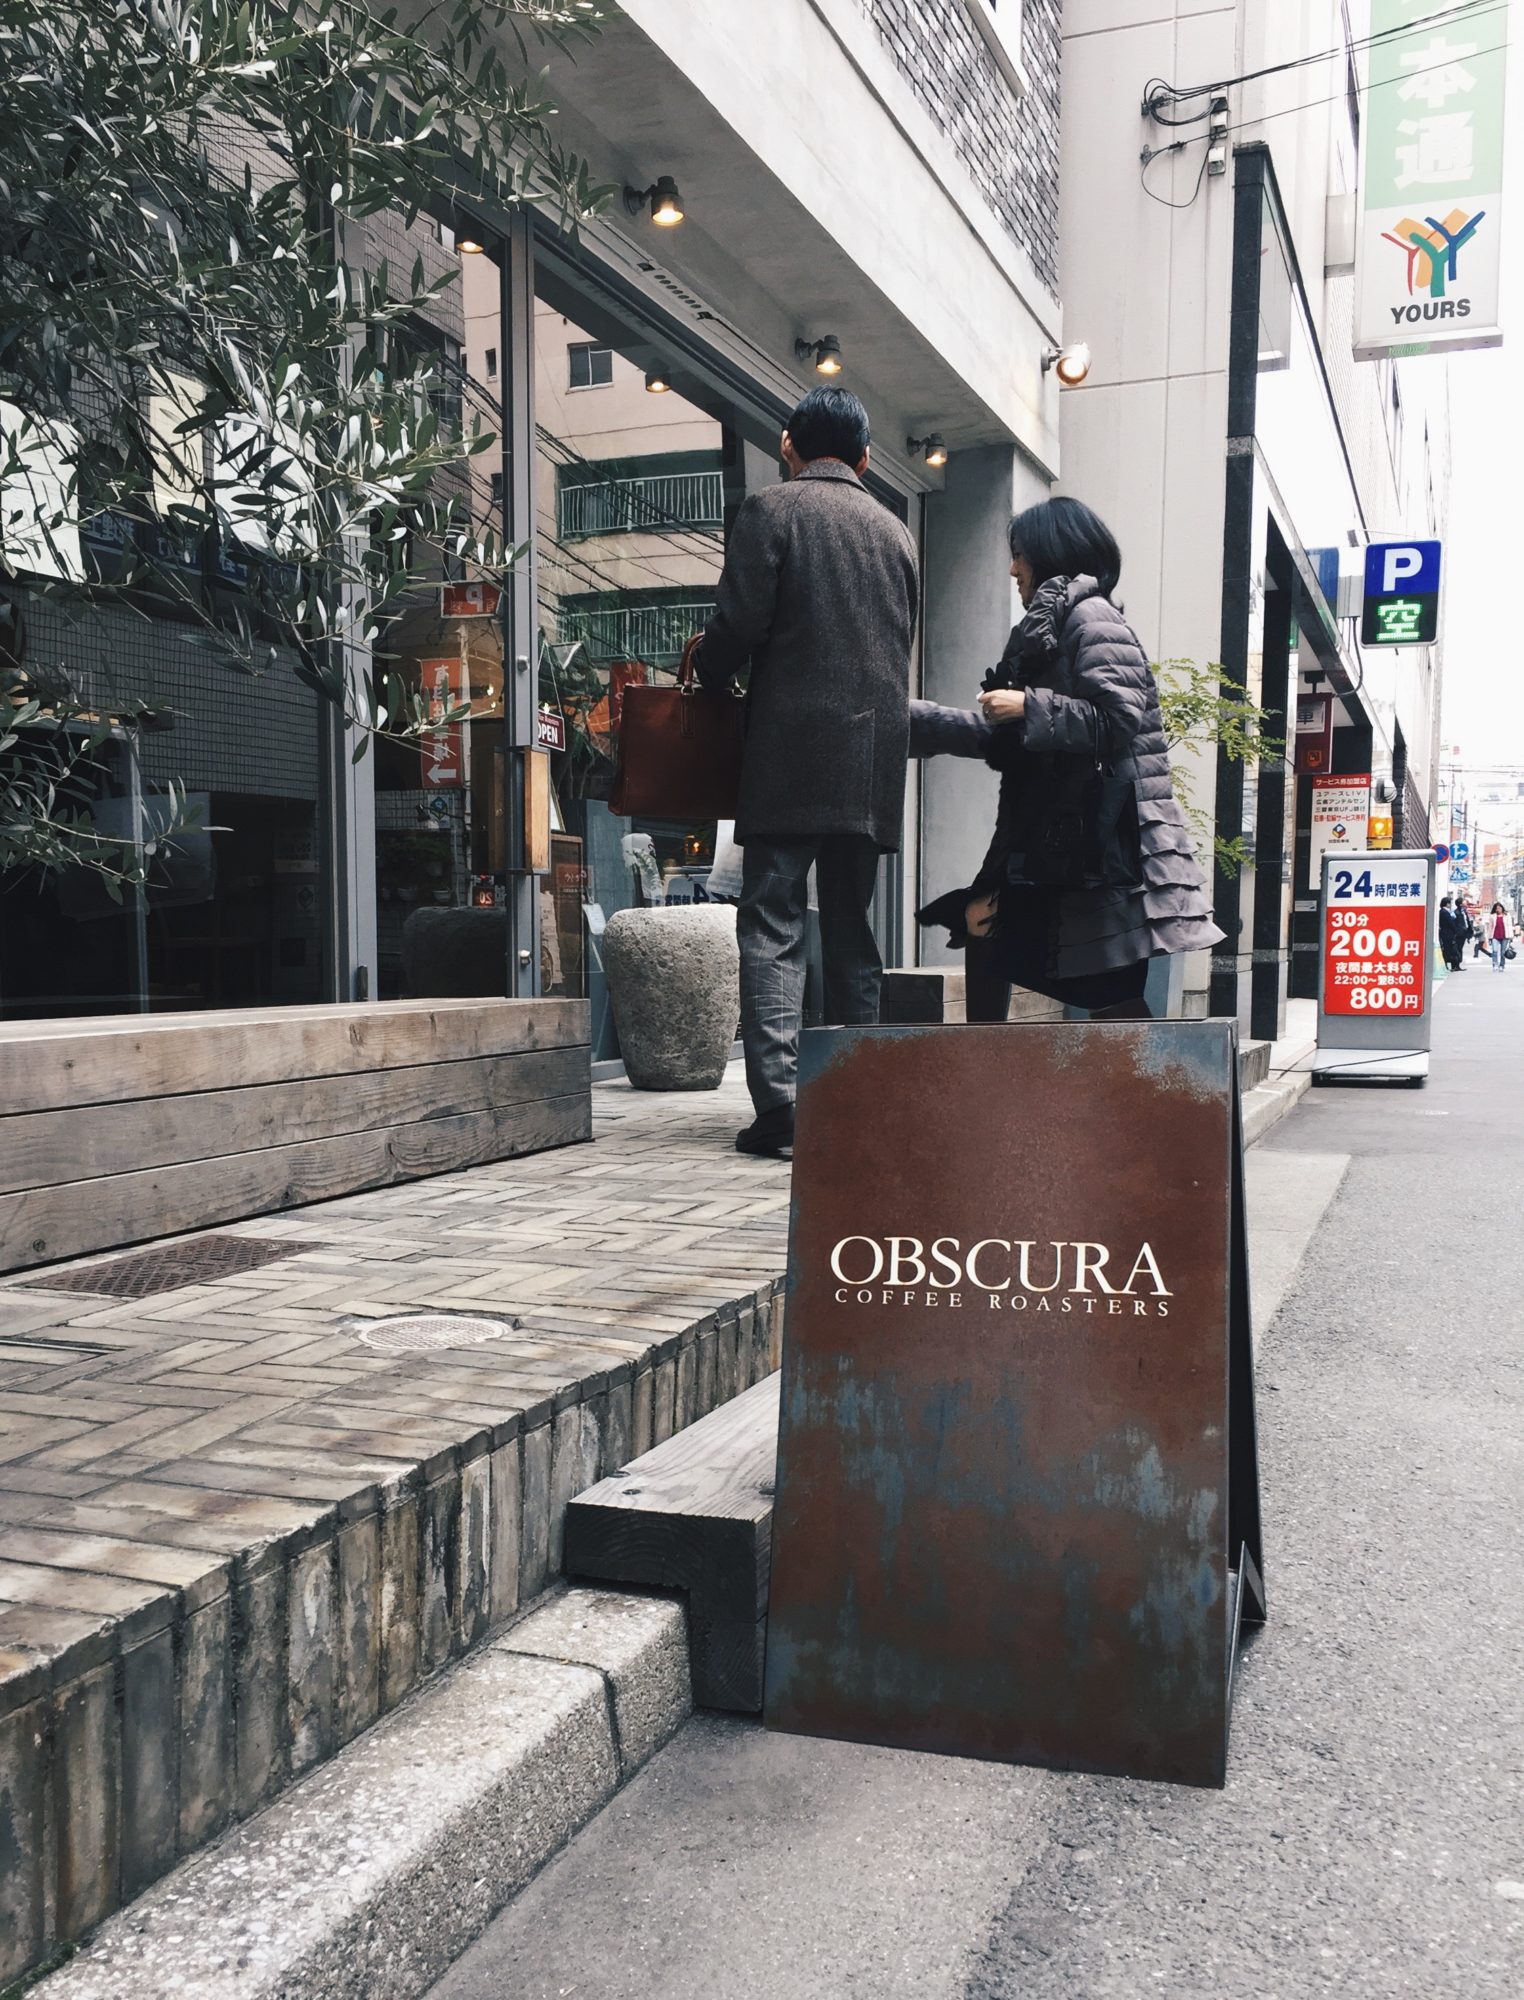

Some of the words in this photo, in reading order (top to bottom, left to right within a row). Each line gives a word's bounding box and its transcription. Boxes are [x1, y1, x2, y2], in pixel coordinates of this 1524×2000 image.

[1390, 298, 1471, 325] YOURS
[1382, 547, 1423, 592] P
[1376, 599, 1422, 641] 空
[1334, 870, 1421, 898] 24時間営業
[1331, 911, 1369, 927] 30分
[1330, 928, 1419, 957] 200円
[1335, 962, 1413, 974] 夜間最大料金
[1350, 987, 1419, 1010] 800円
[830, 1235, 1174, 1297] OBSCURA
[835, 1288, 963, 1308] COFFEE
[989, 1296, 1169, 1317] ROASTERS
